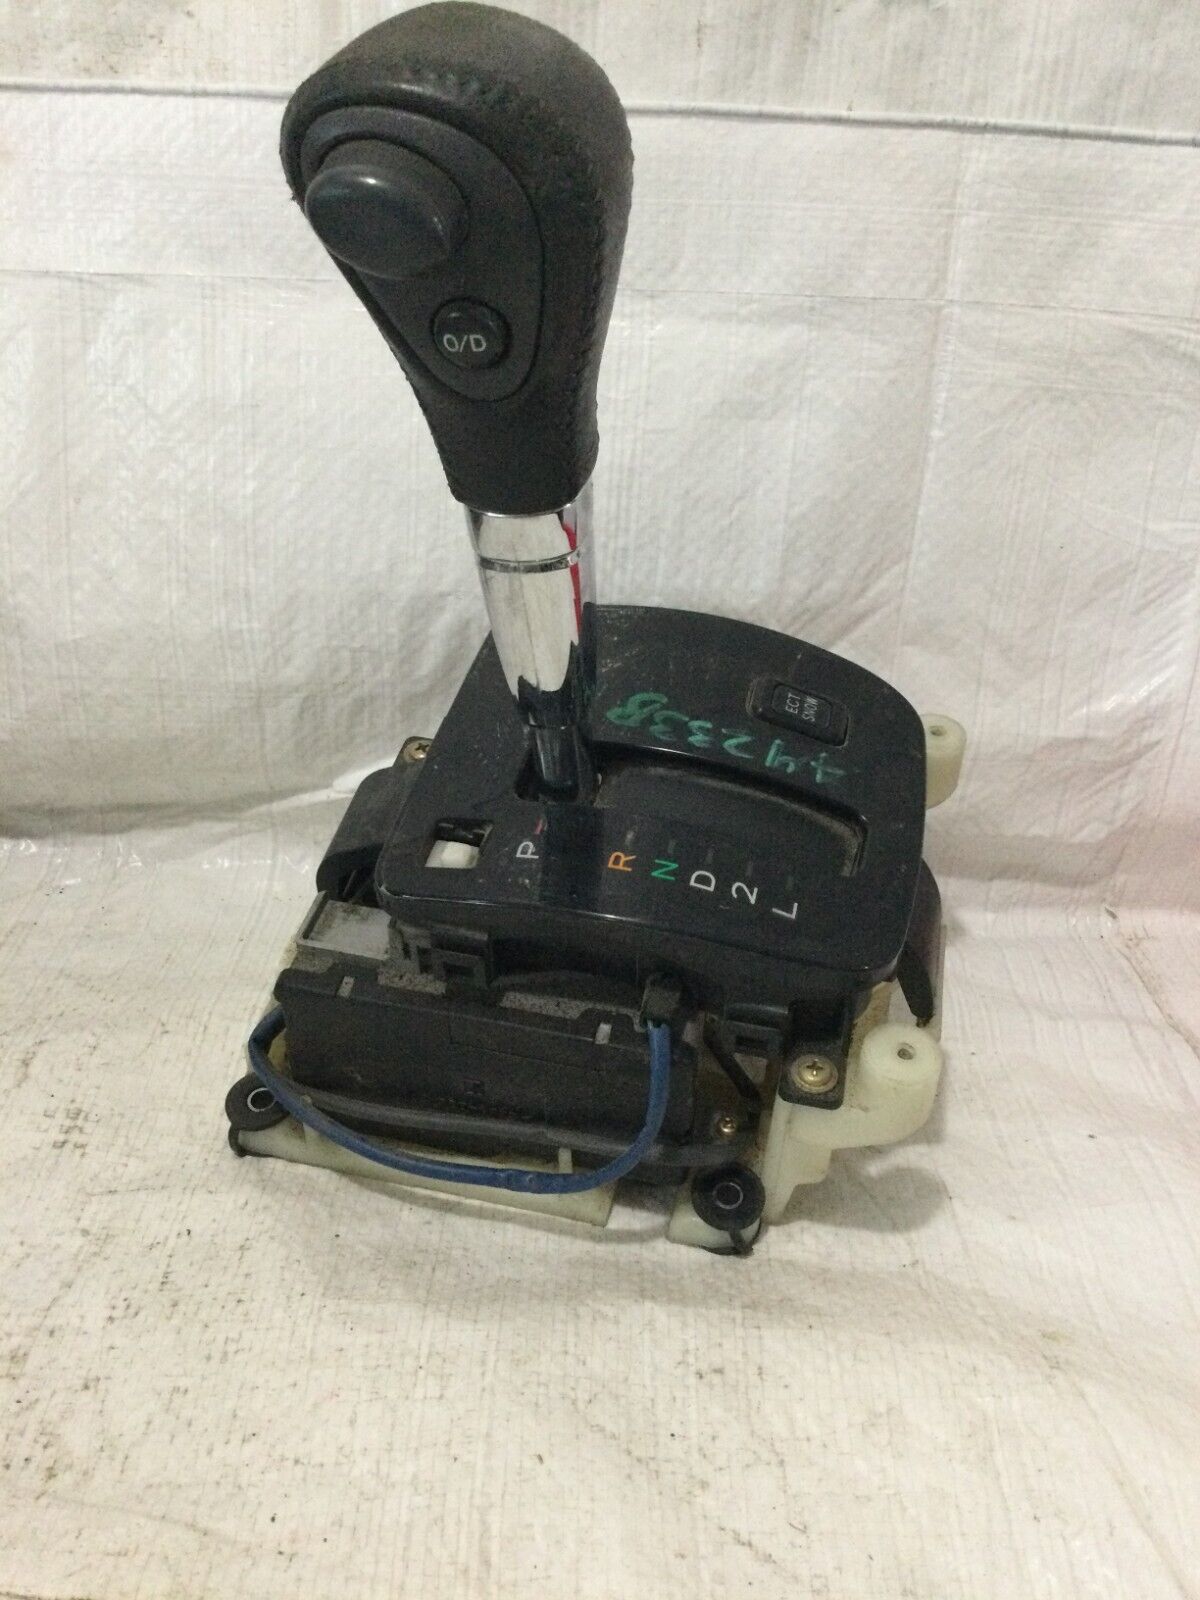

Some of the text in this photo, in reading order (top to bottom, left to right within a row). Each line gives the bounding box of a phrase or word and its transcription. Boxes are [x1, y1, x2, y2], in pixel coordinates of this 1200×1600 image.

[443, 333, 487, 353] O/D
[785, 692, 801, 714] ECT
[802, 695, 819, 722] SNOW
[515, 841, 539, 859] P
[607, 851, 637, 872] R
[651, 859, 679, 881] N
[689, 870, 716, 892] D
[731, 882, 758, 904] 2
[772, 902, 798, 920] L
